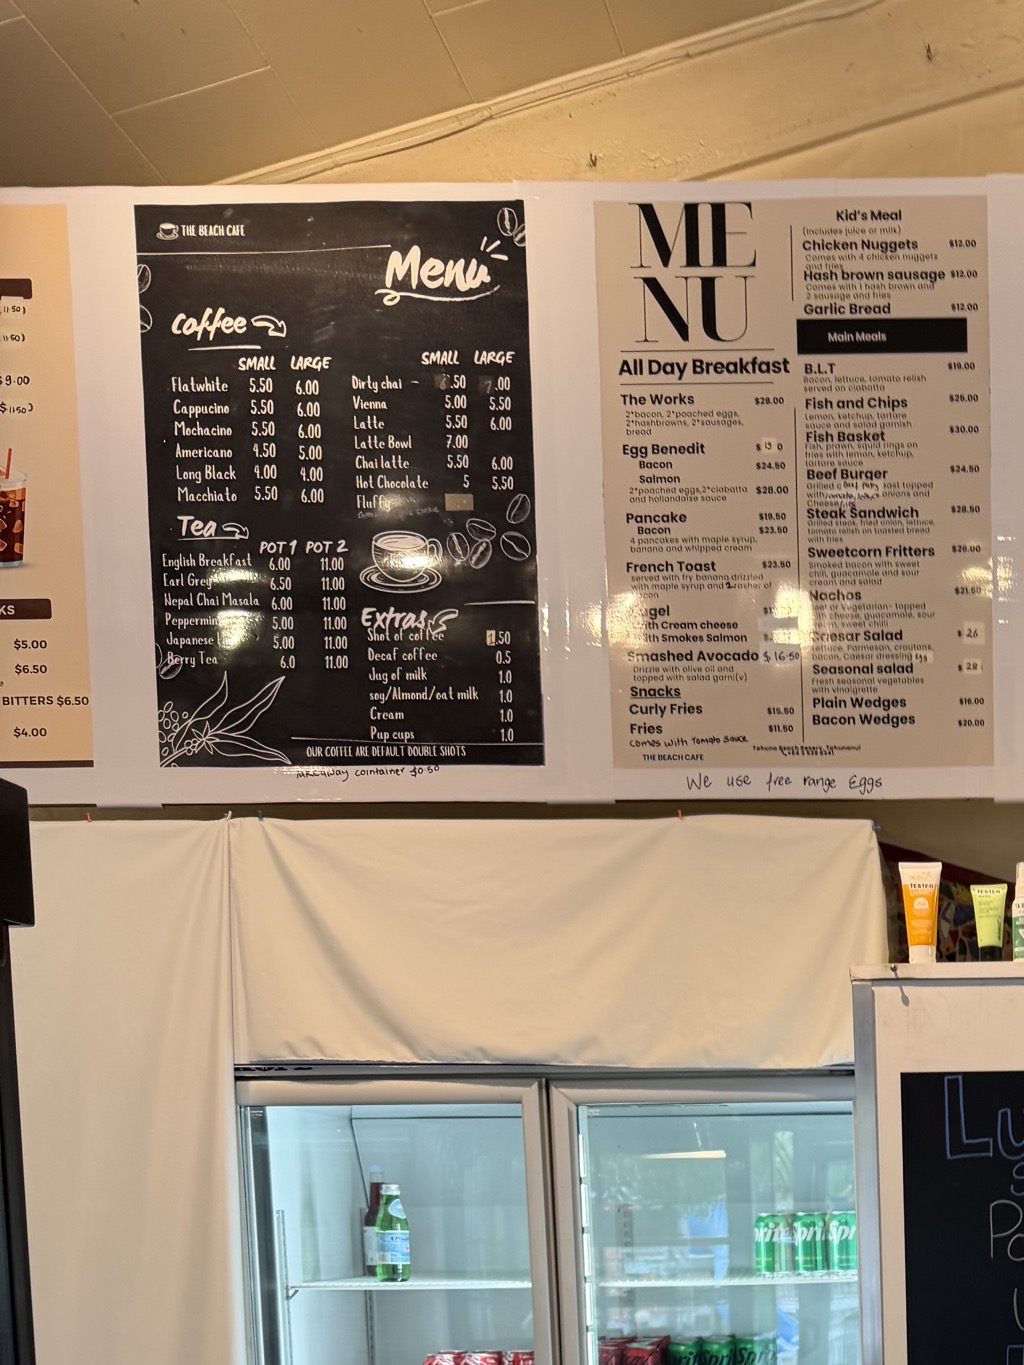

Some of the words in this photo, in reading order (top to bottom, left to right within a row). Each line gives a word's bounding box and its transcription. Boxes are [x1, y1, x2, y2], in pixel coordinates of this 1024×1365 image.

[836, 210, 868, 222] Kid's
[871, 210, 902, 221] Meal
[181, 224, 196, 237] THE
[199, 224, 224, 236] BEACH
[226, 224, 245, 236] CAFE
[629, 202, 757, 268] ME
[802, 239, 858, 251] Chicken
[861, 239, 918, 254] Nuggets
[386, 246, 490, 291] Menu
[633, 276, 755, 342] NU
[828, 331, 854, 343] Main
[856, 331, 887, 342] Meals
[238, 356, 276, 371] SMALL
[291, 356, 331, 370] LARGE
[421, 352, 459, 365] SMALL
[474, 351, 514, 365] LARGE
[619, 360, 644, 376] All
[648, 359, 688, 380] Day
[692, 358, 790, 375] Breakfast
[172, 377, 228, 392] Flatwhite
[249, 378, 272, 394] 5.50
[296, 379, 319, 396] 6.00
[621, 394, 648, 405] The
[651, 394, 694, 405] Works
[755, 396, 784, 406] $28.00
[805, 398, 830, 410] Fish
[832, 398, 867, 409] and
[869, 396, 907, 412] Chips
[354, 417, 384, 430] Latte
[446, 415, 468, 429] 5.50
[490, 417, 512, 431] 6.00
[176, 445, 233, 459] Americano
[253, 443, 276, 458] 4.50
[299, 446, 322, 461] 5.00
[177, 516, 216, 537] Tea
[163, 554, 196, 570] English
[199, 553, 252, 568] Breakfast
[269, 557, 291, 571] 6.00
[320, 558, 344, 571] 11.00
[361, 608, 427, 631] Extras
[15, 663, 48, 675] $6.50
[630, 686, 681, 699] Snacks
[812, 714, 857, 726] Bacon
[859, 714, 915, 729] Wedges
[307, 747, 322, 757] OUR
[325, 747, 353, 757] COFFEE
[355, 746, 369, 757] ARE
[372, 746, 405, 757] DEFAULT
[407, 745, 437, 757] DOUBLE
[440, 745, 466, 757] SHOTS
[687, 774, 712, 791] We
[727, 776, 751, 787] use
[766, 773, 792, 793] free
[803, 776, 836, 794] range
[848, 776, 882, 794] Eggs
